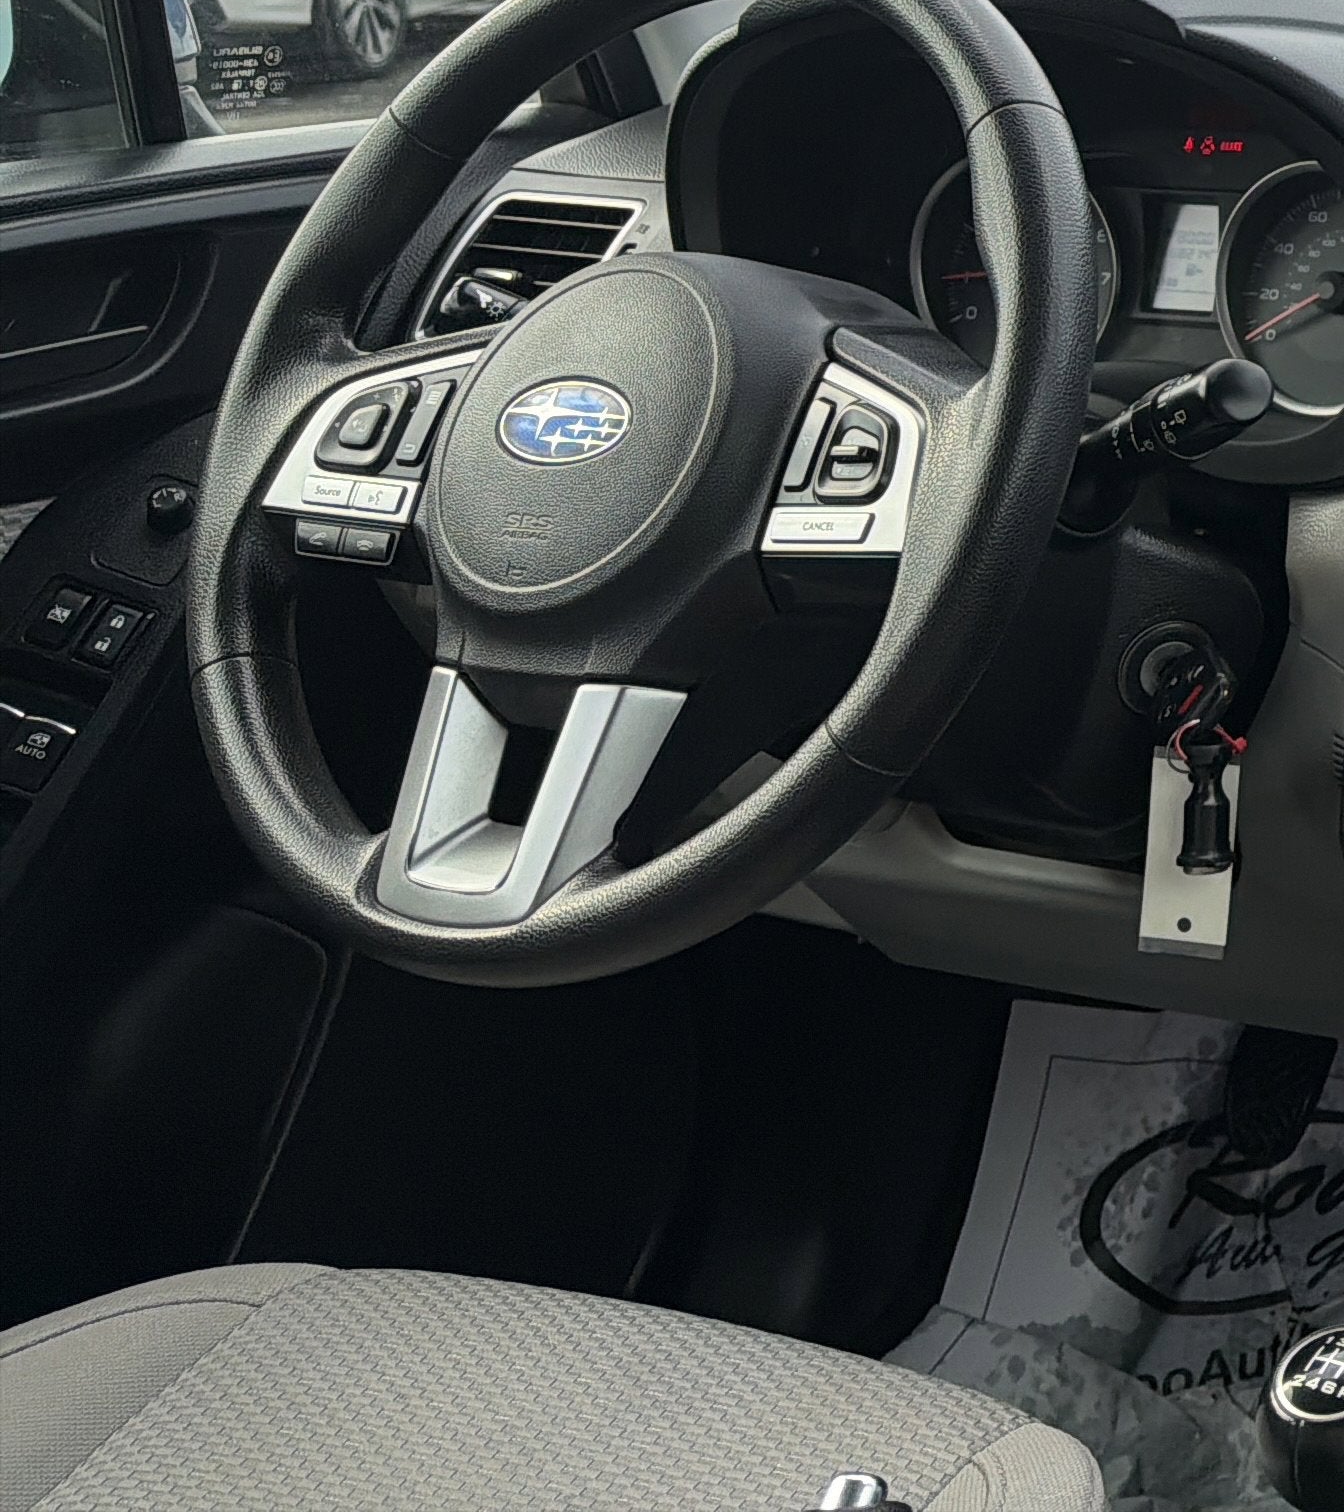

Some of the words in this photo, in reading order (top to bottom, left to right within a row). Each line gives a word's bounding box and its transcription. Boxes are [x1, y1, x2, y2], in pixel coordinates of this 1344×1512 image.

[1308, 211, 1328, 224] 60
[1275, 243, 1294, 256] 40
[1101, 271, 1112, 286] 7
[1260, 288, 1280, 301] 20
[965, 305, 979, 321] 0
[1266, 328, 1277, 341] 0
[314, 482, 342, 497] Source
[504, 511, 553, 529] SRS
[802, 521, 835, 532] CANCEL
[15, 744, 46, 760] AUTO
